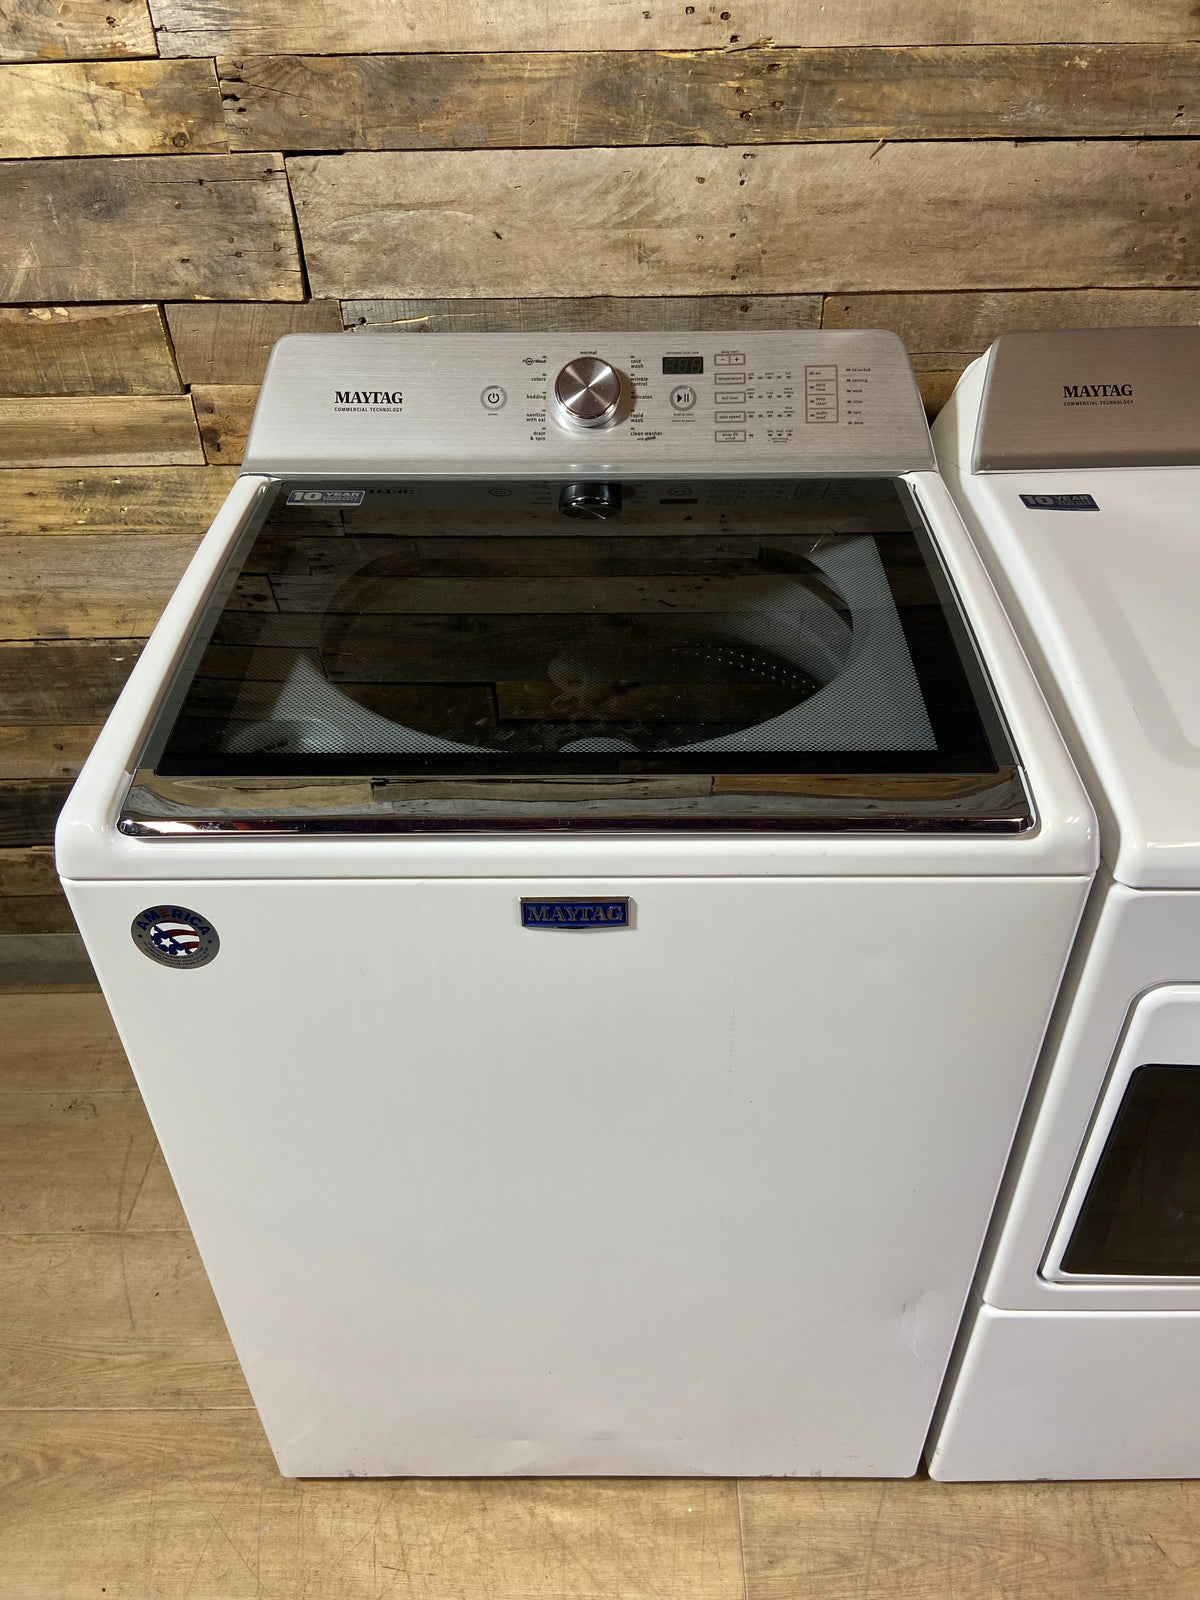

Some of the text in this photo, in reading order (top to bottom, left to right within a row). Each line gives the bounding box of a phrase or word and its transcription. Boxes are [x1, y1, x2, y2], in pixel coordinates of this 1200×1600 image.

[335, 391, 403, 404] MAYTAG
[1063, 384, 1133, 398] MAYTAG
[294, 492, 322, 501] 10
[1023, 496, 1055, 505] 10
[527, 906, 623, 922] MAYTAG
[136, 908, 210, 935] AMERICA
